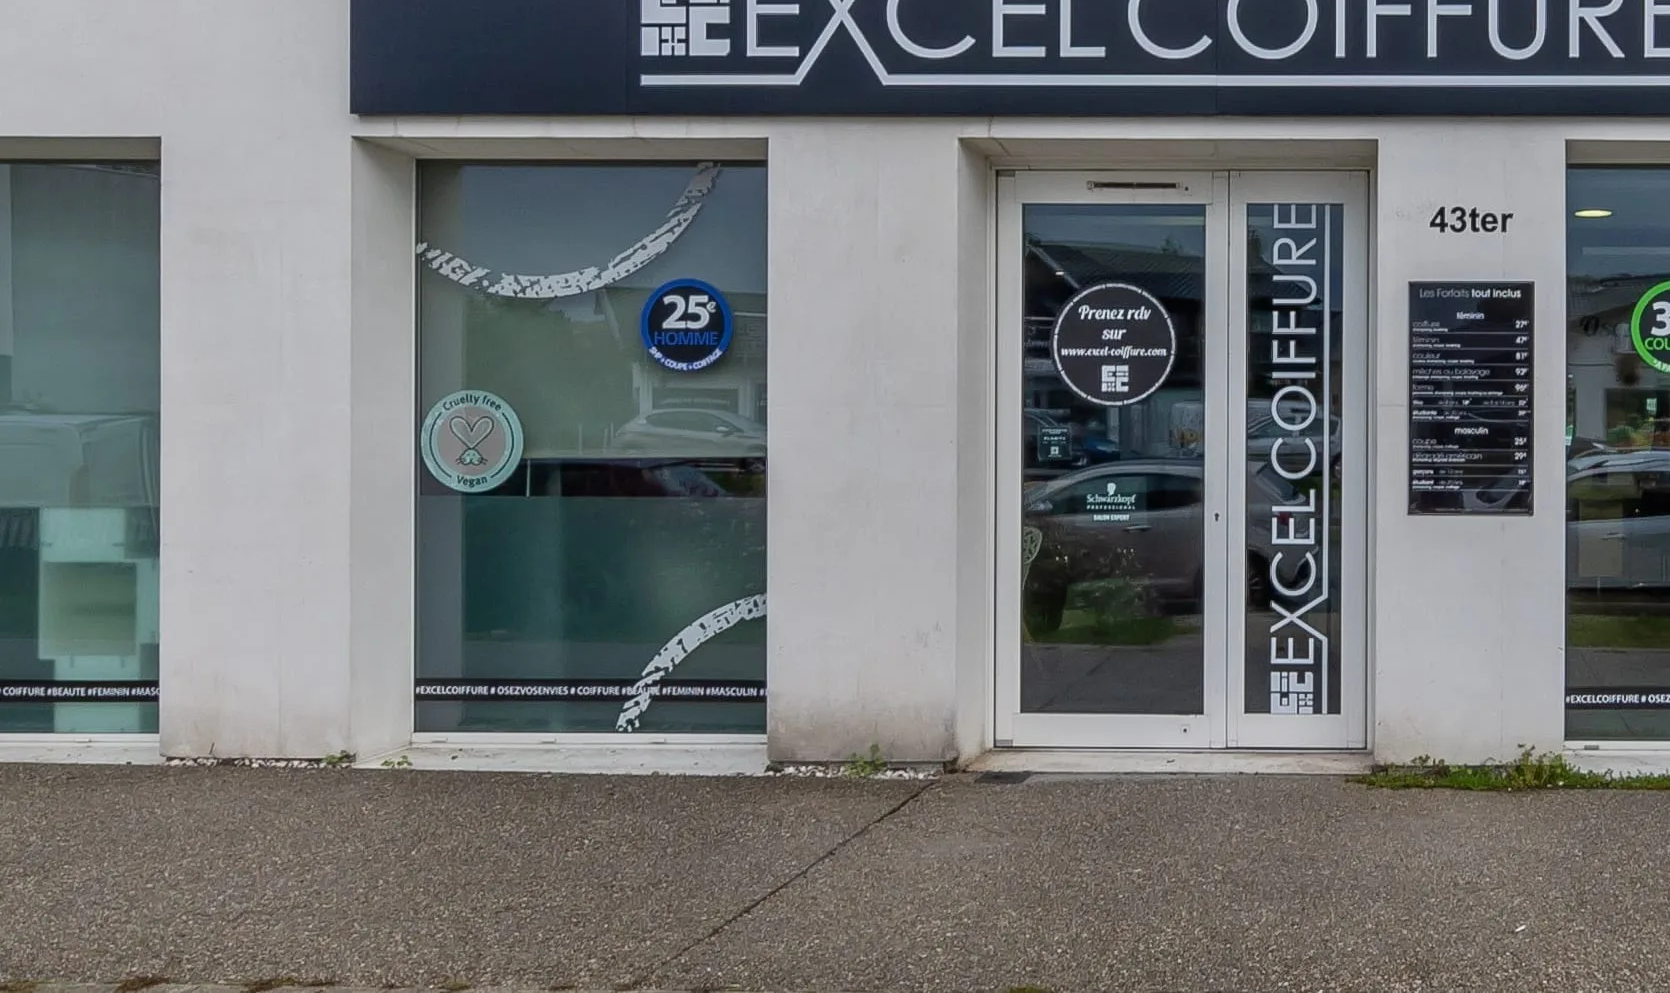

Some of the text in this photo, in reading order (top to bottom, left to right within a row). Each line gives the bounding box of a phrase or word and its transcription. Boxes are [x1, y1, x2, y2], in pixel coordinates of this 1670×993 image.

[1429, 205, 1514, 234] 43ter
[1471, 288, 1491, 298] tout
[1492, 288, 1522, 298] inclus
[1078, 304, 1152, 320] Prenez rdv
[653, 331, 720, 346] HOMME
[1101, 328, 1127, 340] sur
[1061, 345, 1168, 359] www.excel-coiffure.com
[442, 393, 502, 411] Cruelty free
[1270, 203, 1317, 665] EXCEL COIFFURE
[456, 475, 488, 488] Vegan
[1086, 493, 1137, 505] Schwarzkopf
[2, 686, 46, 697] COIFFURE
[47, 686, 87, 697] #BEAUTE
[87, 686, 130, 697] #FEMININ
[415, 685, 489, 695] #EXCELCOIFFURE
[497, 685, 569, 695] OSEZVOSENVIES
[577, 686, 620, 696] COIFFURE
[662, 687, 705, 696] #FEMININ
[705, 687, 758, 697] #MASCULIN
[1565, 694, 1640, 704] #EXCELCOIFFURE
